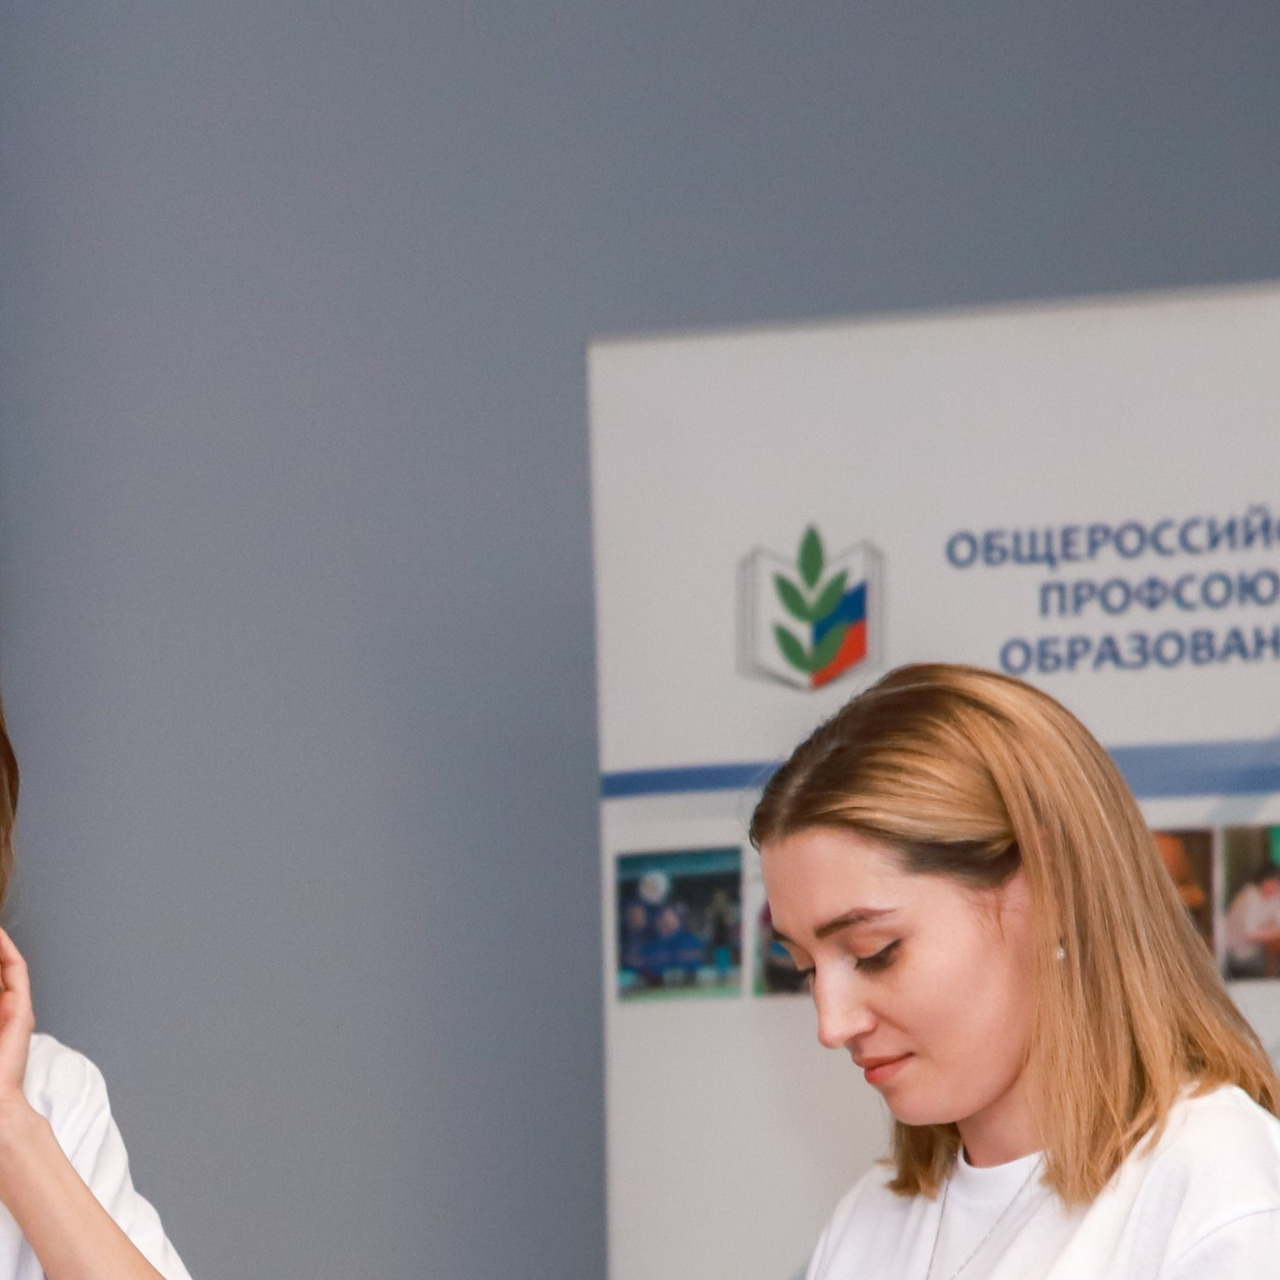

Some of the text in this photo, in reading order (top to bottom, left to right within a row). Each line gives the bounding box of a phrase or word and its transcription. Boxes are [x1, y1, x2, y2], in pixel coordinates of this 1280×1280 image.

[945, 504, 1280, 571] ОБЩЕРОССИЙ
[1039, 568, 1280, 619] ПРОФСОЮ
[999, 624, 1280, 675] ОБРАЗОВАН
